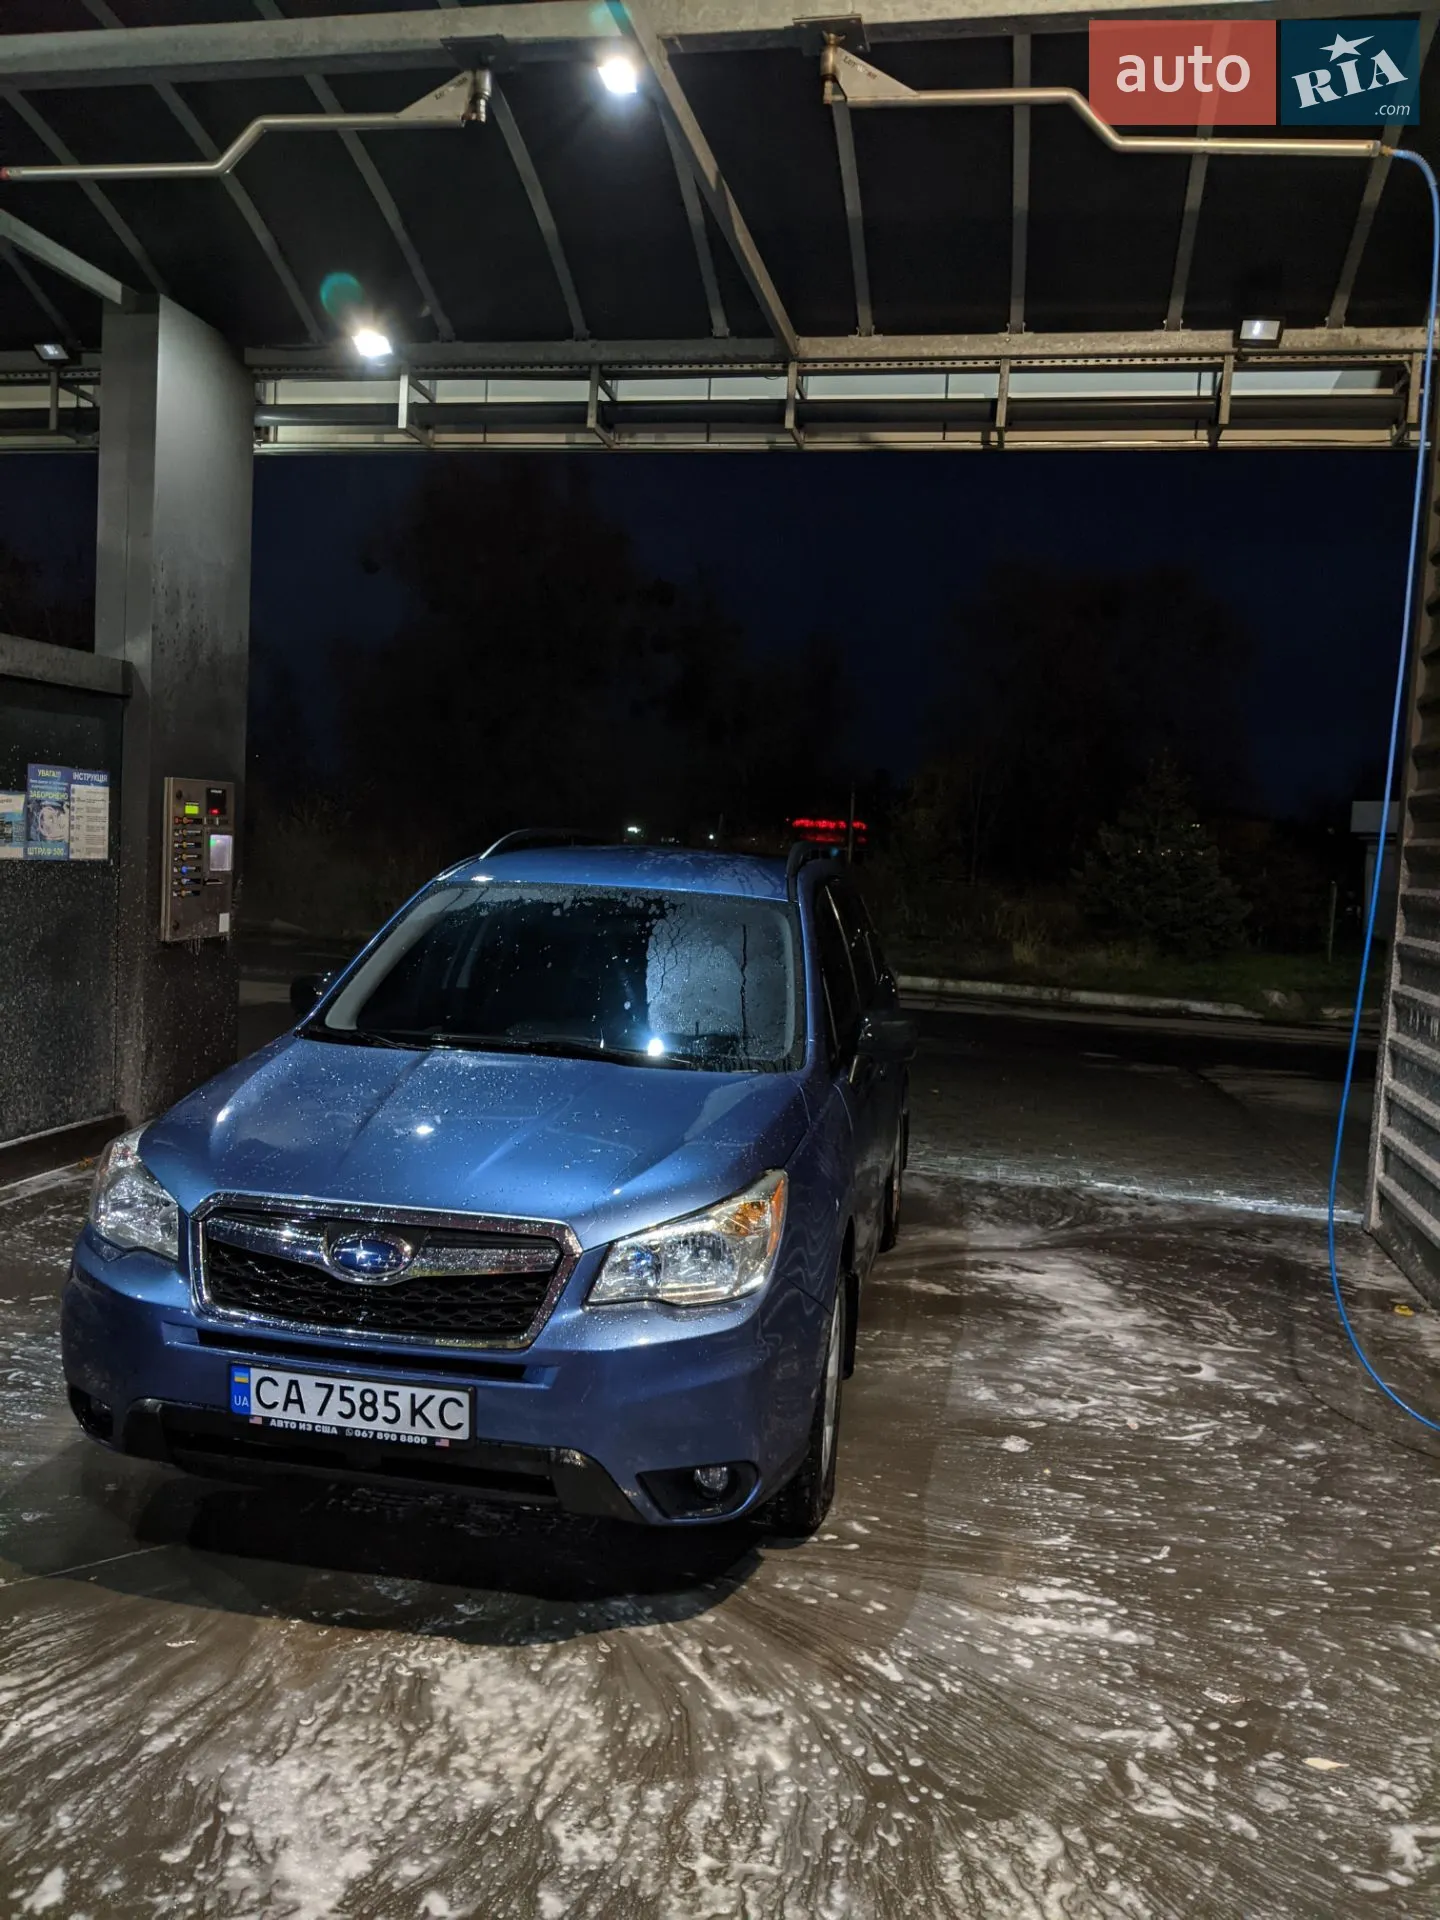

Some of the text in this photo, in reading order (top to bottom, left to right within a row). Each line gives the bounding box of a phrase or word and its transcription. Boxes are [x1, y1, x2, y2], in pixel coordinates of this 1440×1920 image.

[234, 1394, 249, 1408] UA
[269, 1418, 338, 1435] АВТО ИЗ США
[354, 1428, 374, 1439] 067
